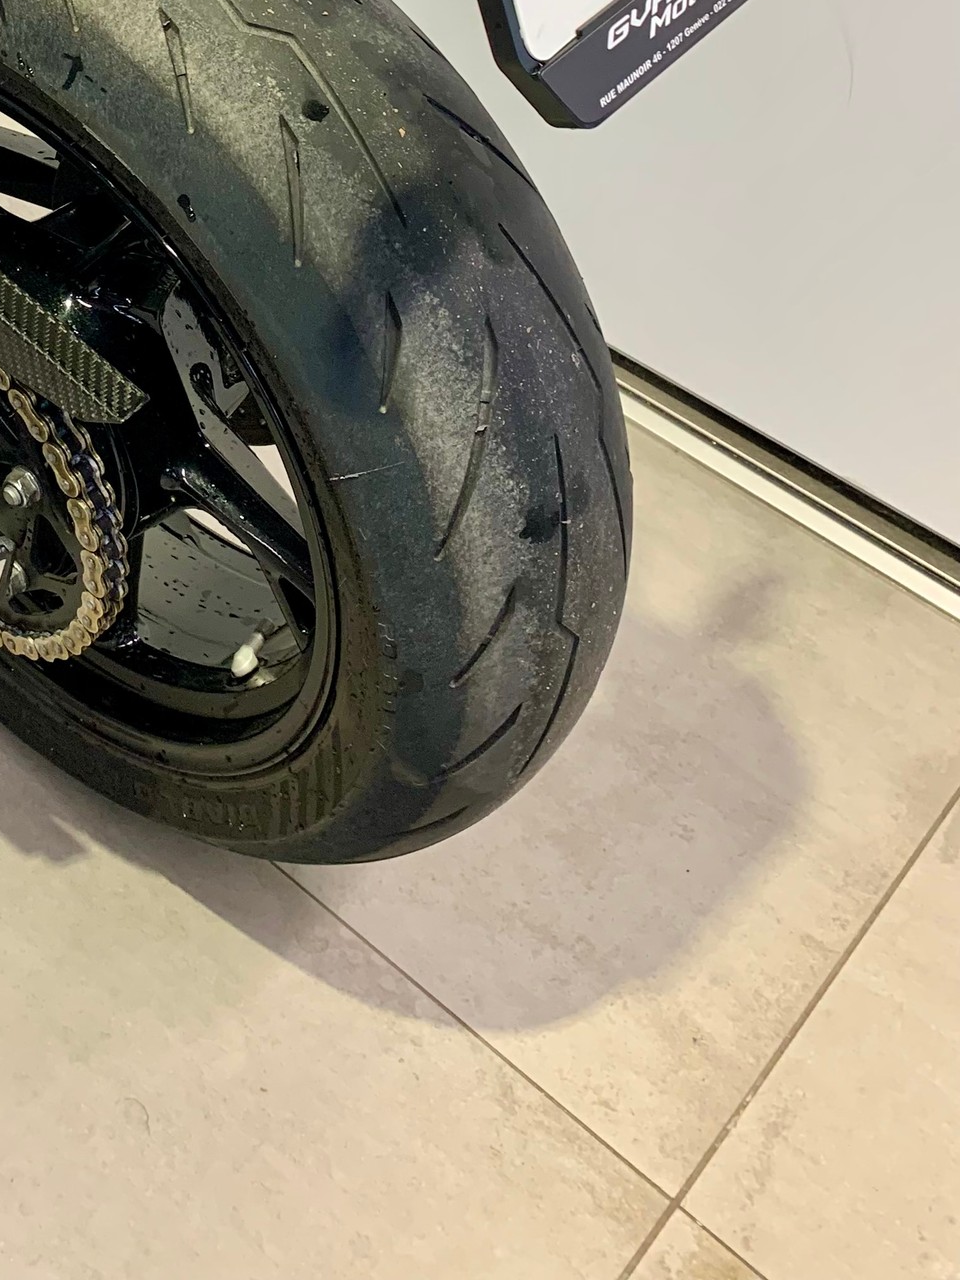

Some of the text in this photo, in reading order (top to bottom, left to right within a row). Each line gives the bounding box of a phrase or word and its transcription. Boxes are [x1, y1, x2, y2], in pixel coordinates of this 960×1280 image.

[599, 88, 617, 108] RUE
[616, 59, 652, 94] MAUNOIR
[652, 51, 662, 63] 46
[666, 32, 684, 51] 1207
